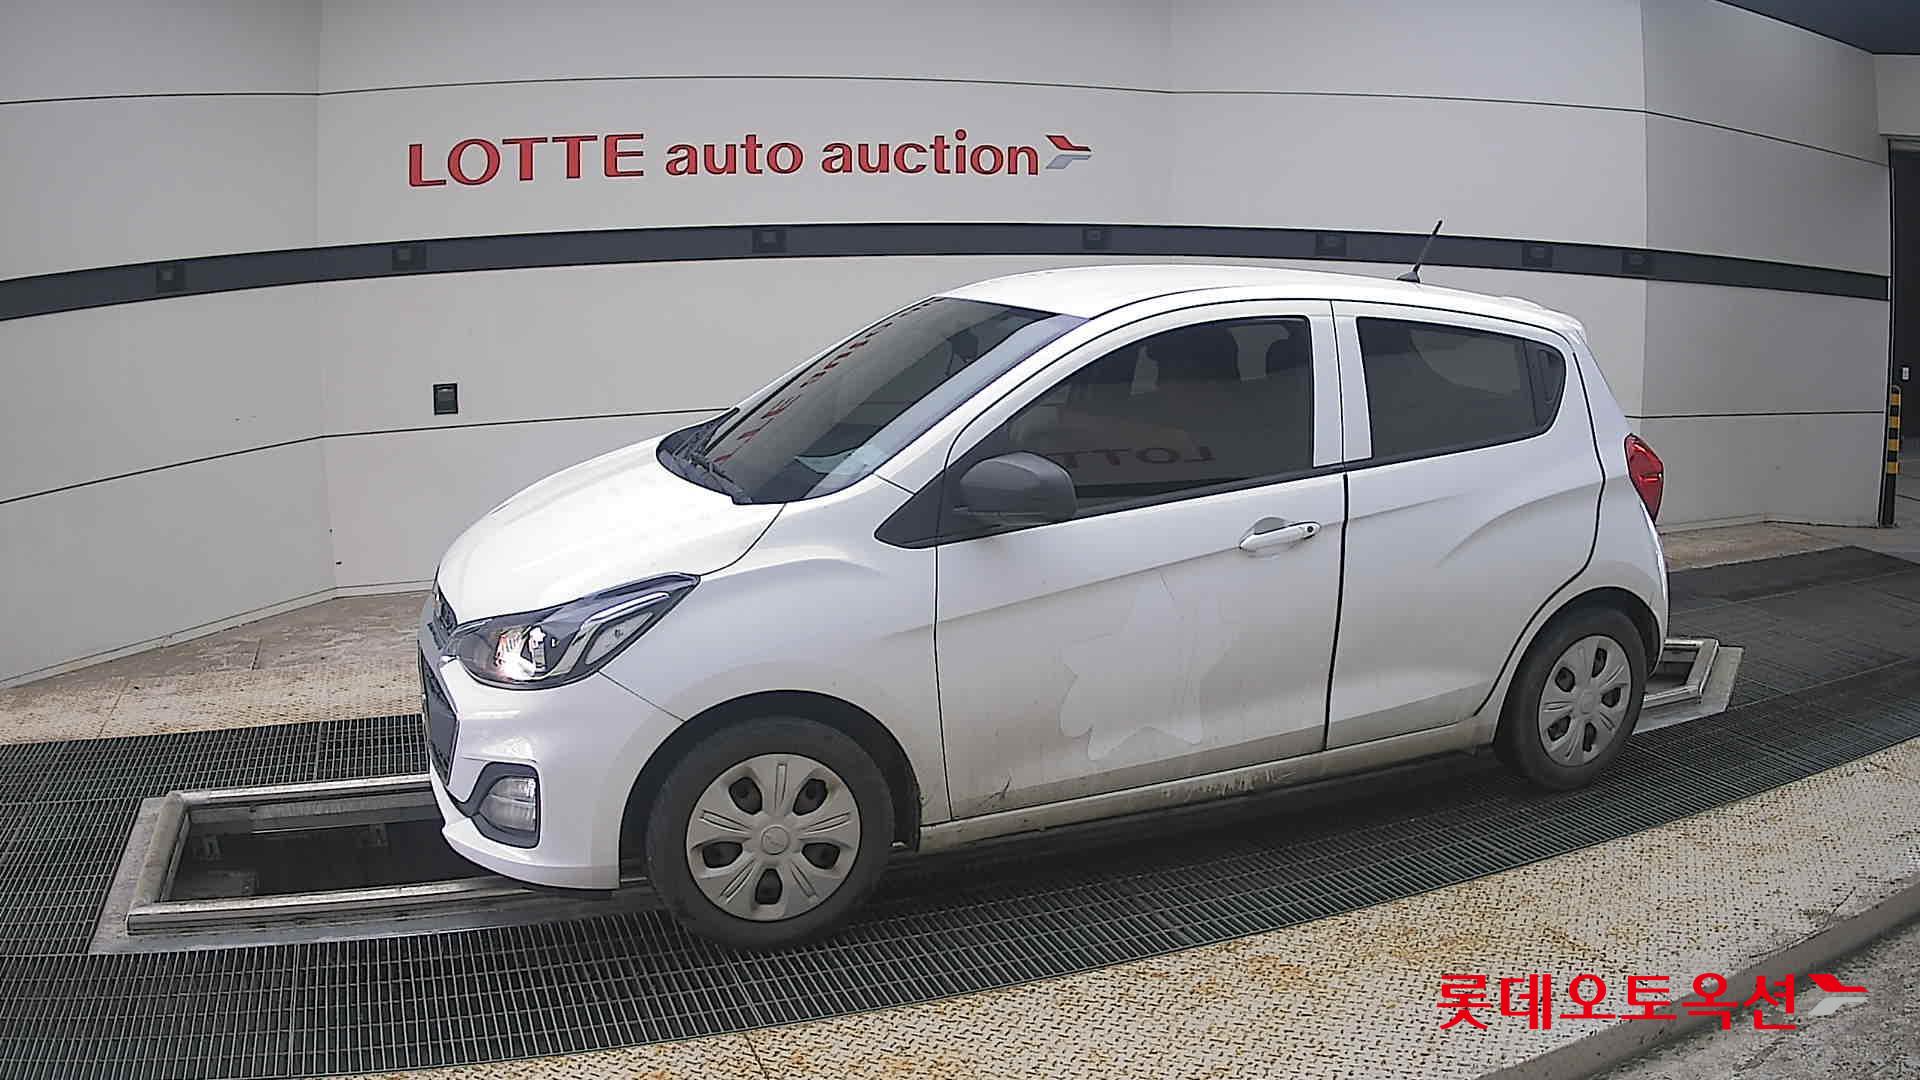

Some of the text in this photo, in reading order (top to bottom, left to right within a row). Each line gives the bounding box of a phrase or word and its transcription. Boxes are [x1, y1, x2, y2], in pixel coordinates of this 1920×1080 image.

[408, 128, 1039, 188] LOTTE auto auction
